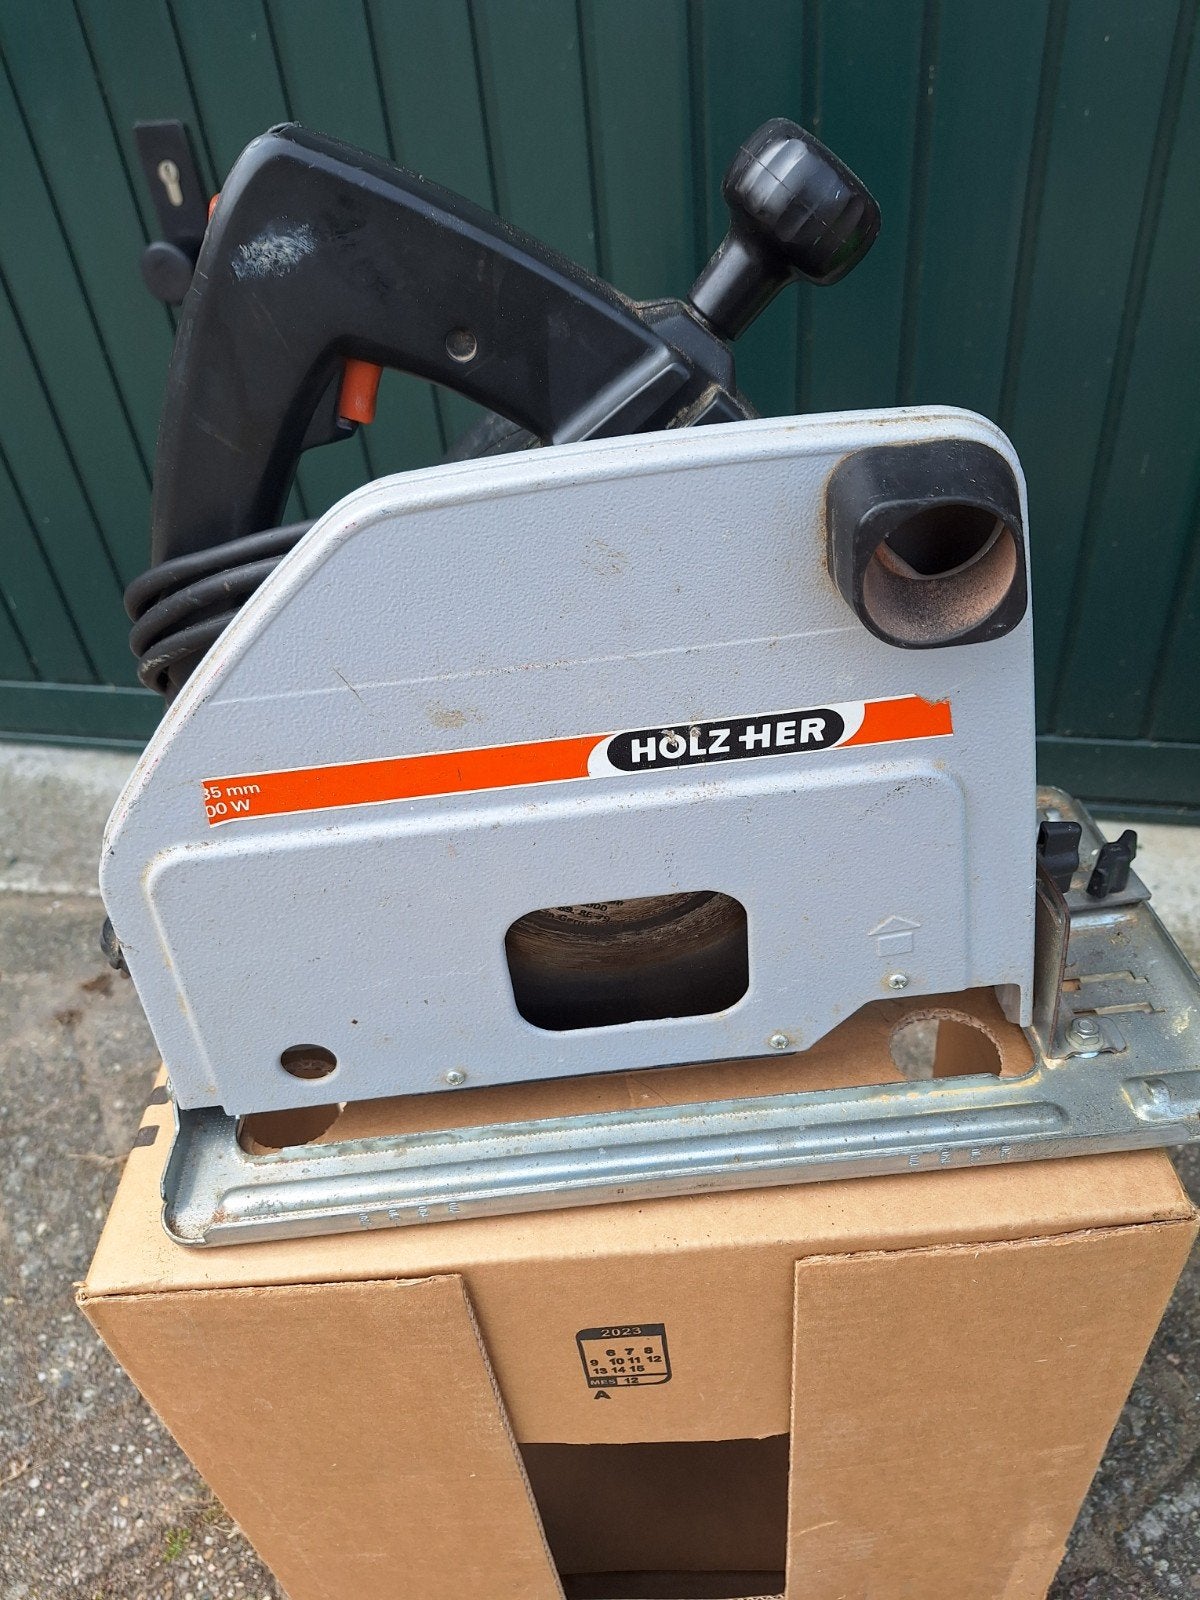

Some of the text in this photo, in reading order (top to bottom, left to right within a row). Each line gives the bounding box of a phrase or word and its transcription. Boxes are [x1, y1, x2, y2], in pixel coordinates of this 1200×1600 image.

[226, 784, 260, 797] mm
[230, 799, 250, 812] W
[600, 1327, 642, 1337] 2023
[625, 1347, 634, 1356] 7
[628, 1356, 641, 1364] 11
[611, 1366, 626, 1374] 14
[594, 1390, 611, 1400] A
